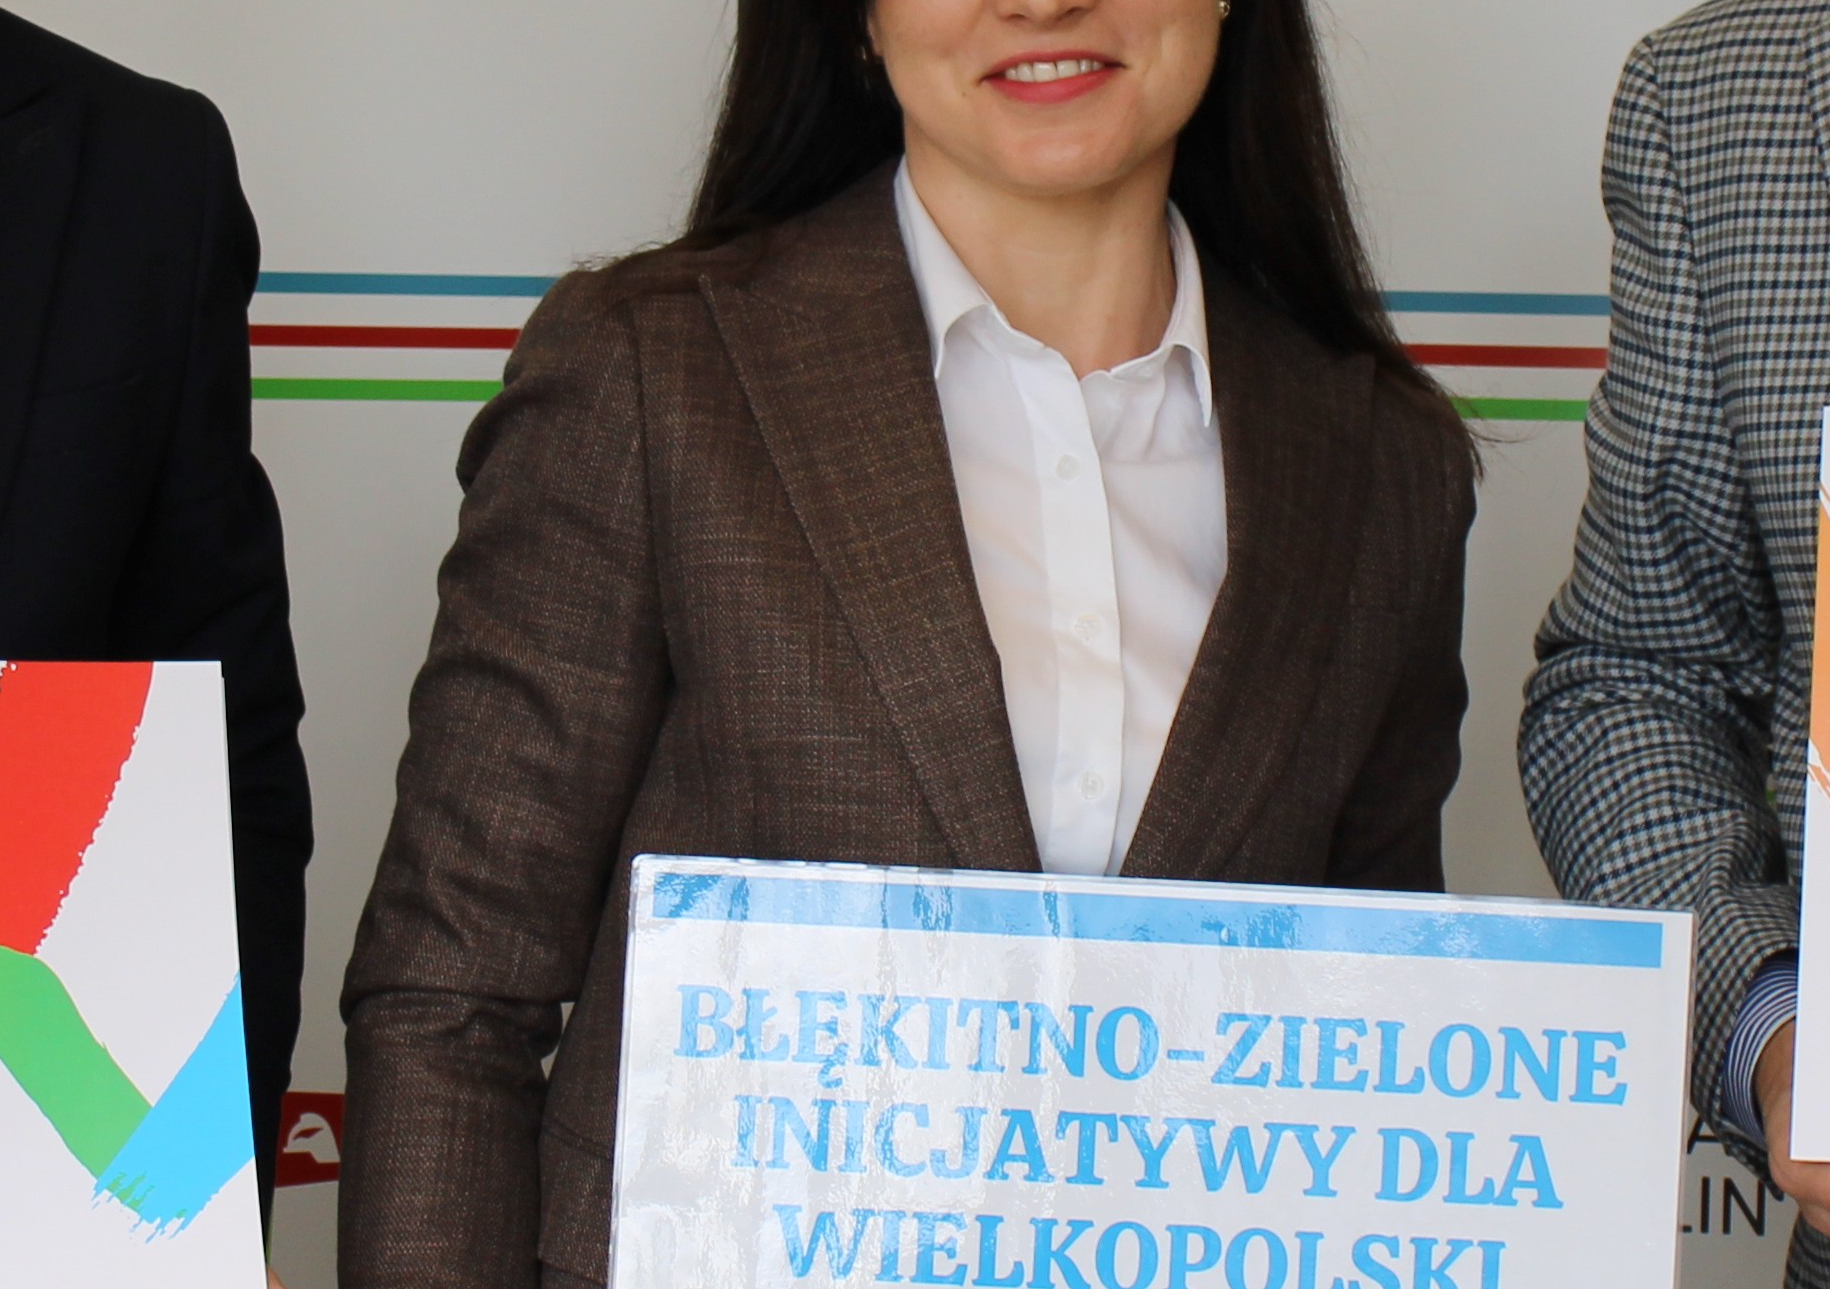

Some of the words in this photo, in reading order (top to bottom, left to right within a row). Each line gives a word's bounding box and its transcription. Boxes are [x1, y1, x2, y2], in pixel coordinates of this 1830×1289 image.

[672, 983, 1629, 1107] BŁĘKITNO-ZIELONE
[730, 1094, 1358, 1198] INICJATYWY
[1373, 1126, 1565, 1210] DLA
